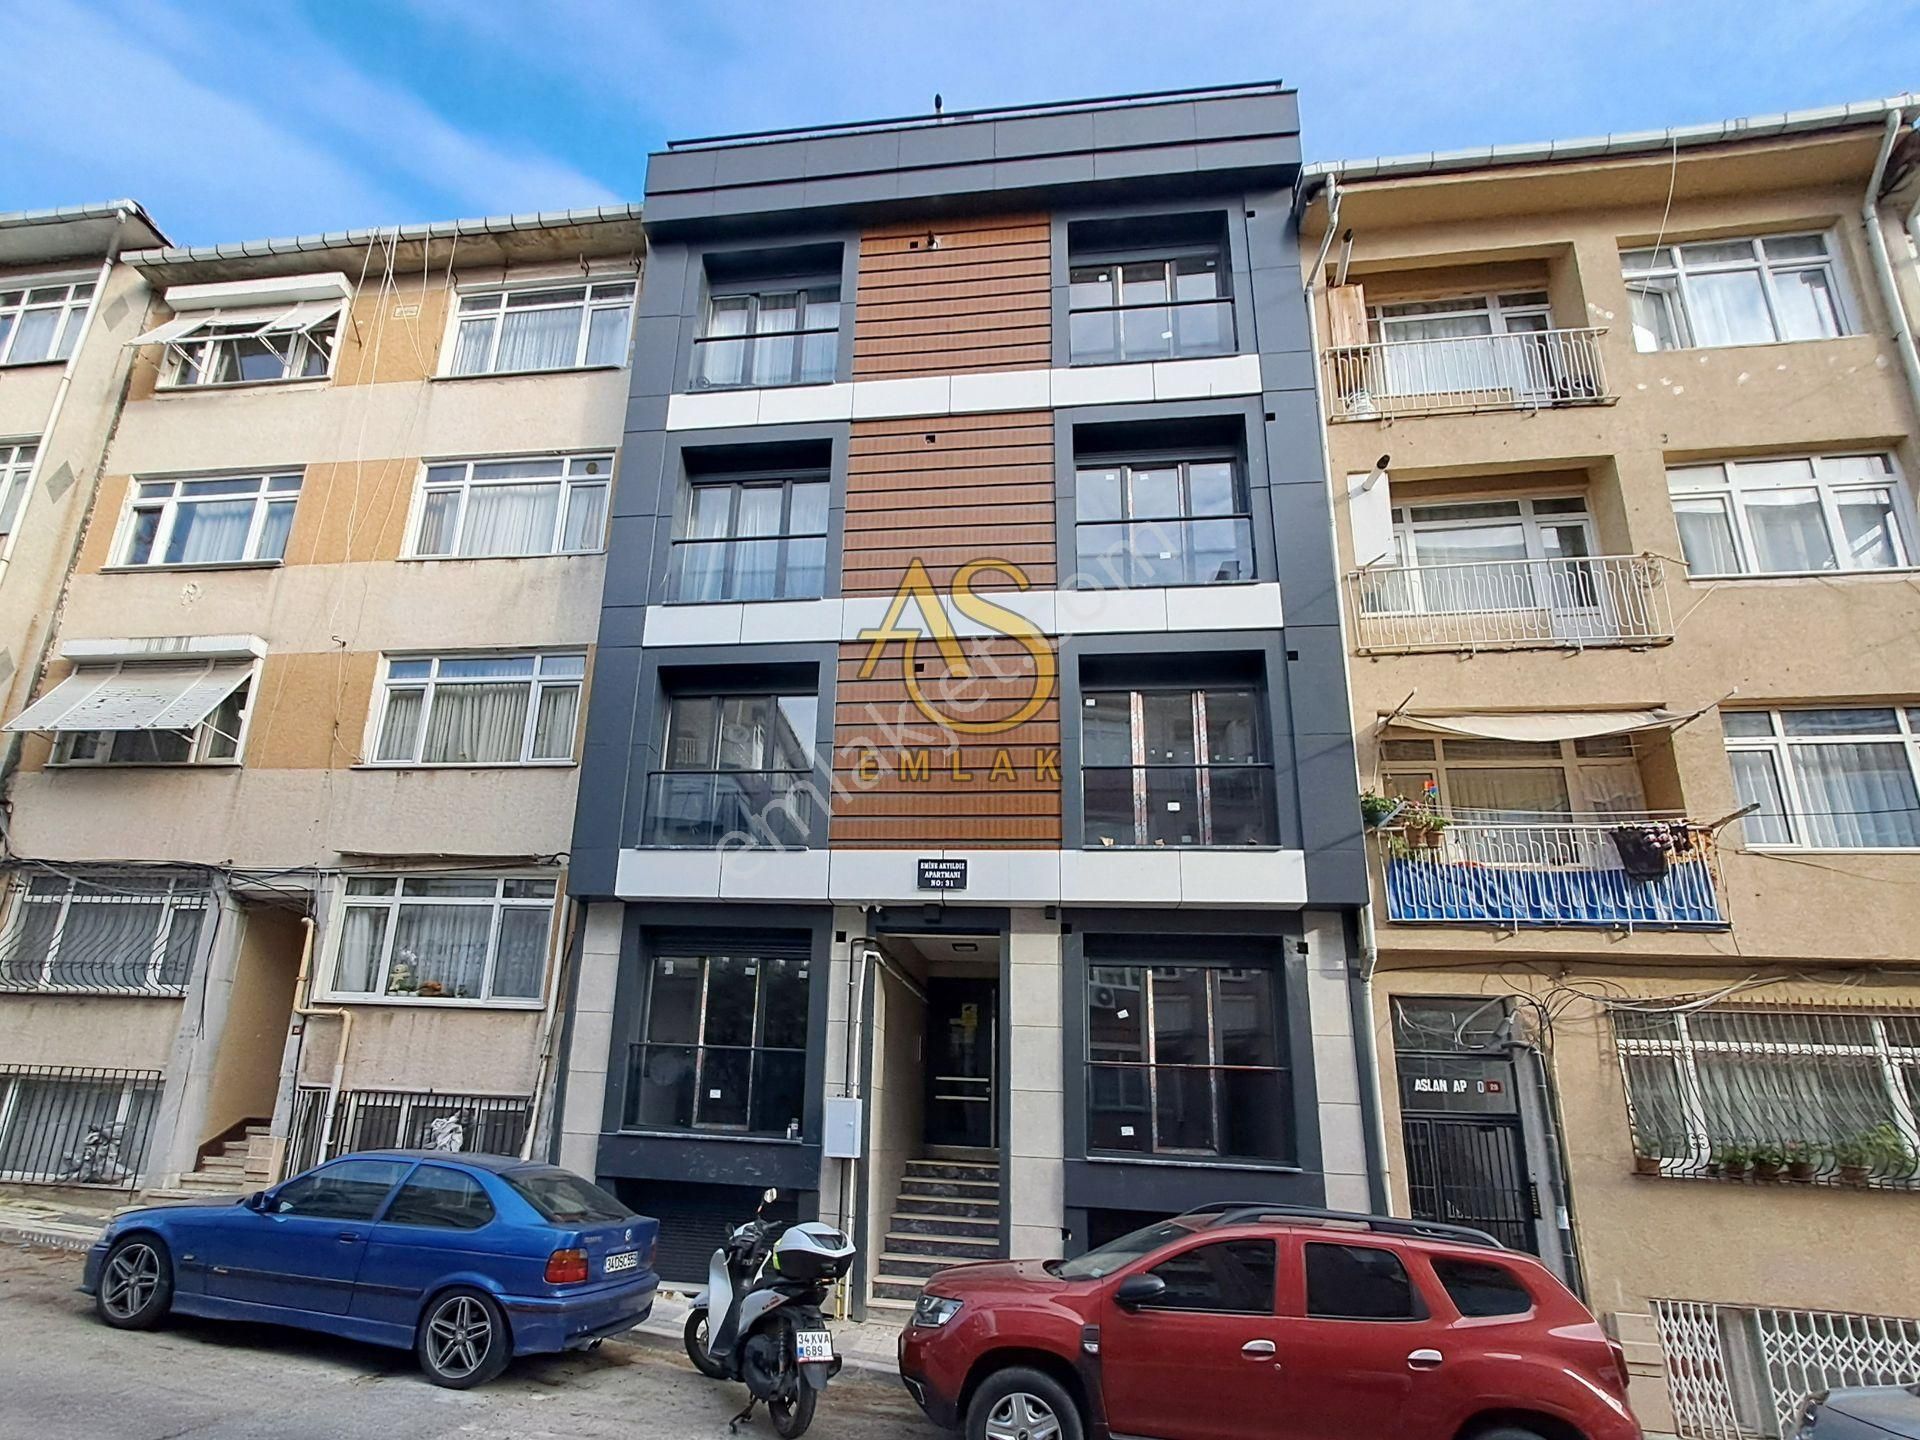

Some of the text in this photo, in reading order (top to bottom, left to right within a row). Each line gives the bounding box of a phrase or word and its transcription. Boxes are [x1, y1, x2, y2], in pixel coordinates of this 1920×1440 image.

[924, 871, 961, 879] APARTMANI
[1415, 1079, 1448, 1093] ASLAN
[1453, 1080, 1467, 1093] AP
[805, 1345, 823, 1356] 689
